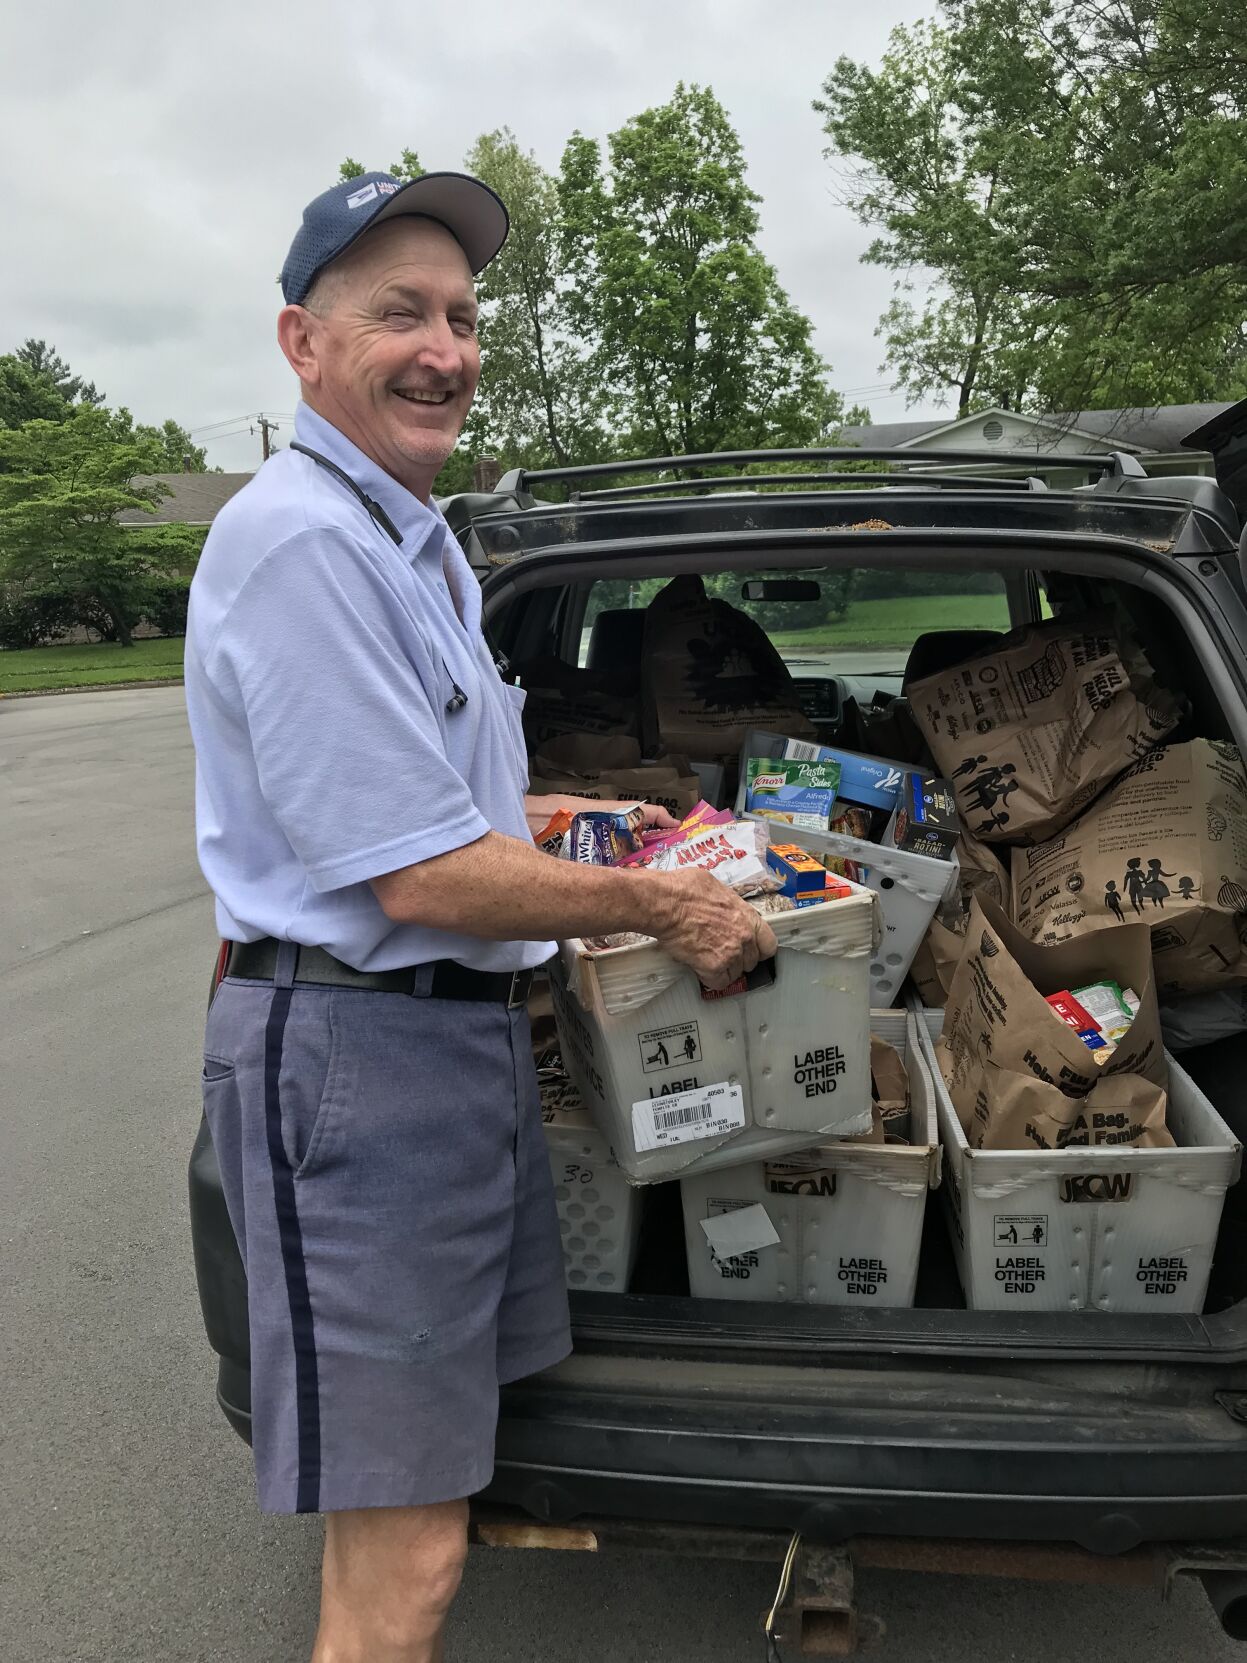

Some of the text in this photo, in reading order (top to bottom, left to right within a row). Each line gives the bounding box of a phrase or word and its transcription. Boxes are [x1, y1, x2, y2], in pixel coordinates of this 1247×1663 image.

[798, 764, 825, 778] Pasta
[753, 776, 784, 788] Knorr
[809, 777, 831, 788] Sides
[913, 842, 941, 853] ROTINI
[1050, 898, 1078, 910] Valassis
[1052, 909, 1086, 926] Kellogg's
[794, 1046, 844, 1069] LABEL
[793, 1061, 846, 1085] OTHER
[649, 1077, 704, 1099] LABEL
[805, 1079, 837, 1098] END
[1074, 1112, 1129, 1129] A Bag.
[563, 1165, 593, 1184] 30
[839, 1257, 887, 1271] LABEL
[995, 1258, 1045, 1269] LABEL
[1139, 1258, 1188, 1269] LABEL
[721, 1266, 750, 1279] END
[838, 1270, 887, 1284] OTHER
[994, 1270, 1045, 1281] OTHER
[1136, 1270, 1187, 1282] OTHER
[846, 1282, 877, 1295] END
[1004, 1282, 1035, 1293] END
[1145, 1283, 1176, 1294] END
